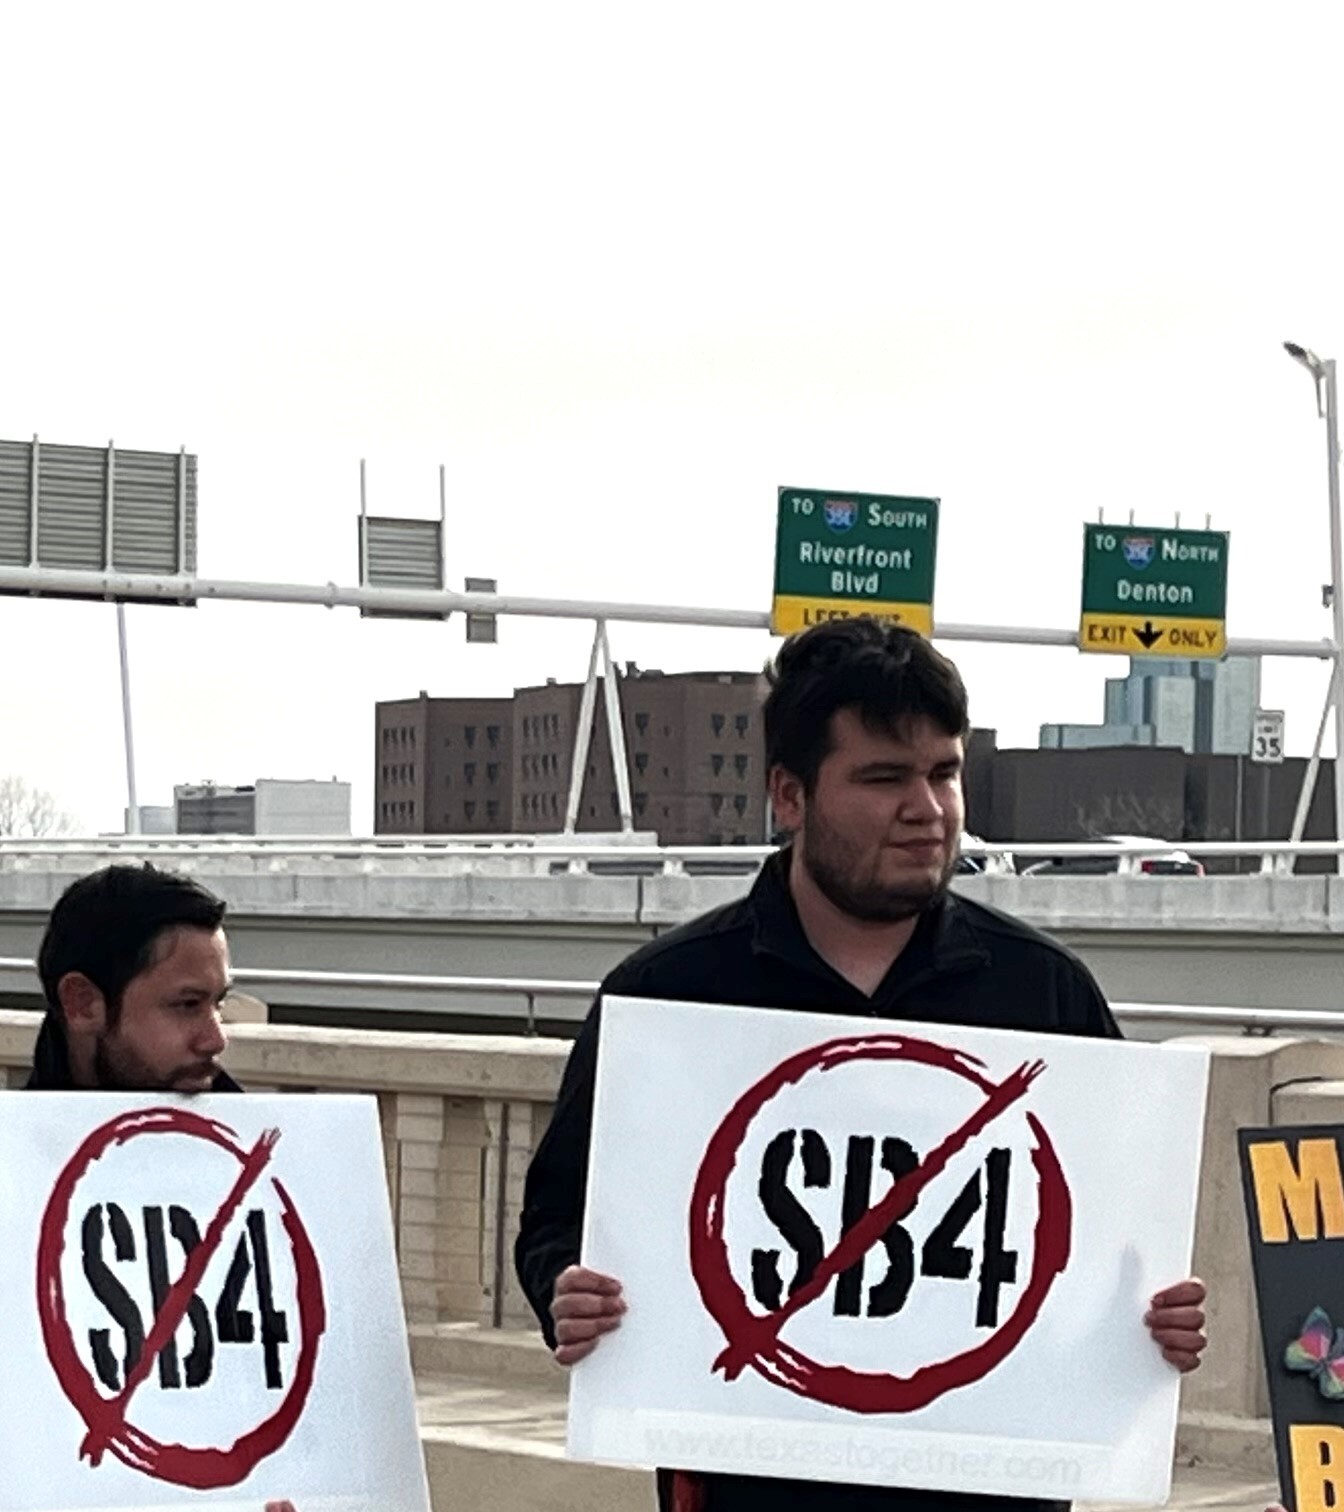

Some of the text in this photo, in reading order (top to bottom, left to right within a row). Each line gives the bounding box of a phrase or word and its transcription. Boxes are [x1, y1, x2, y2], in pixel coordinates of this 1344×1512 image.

[792, 498, 814, 515] TO
[868, 502, 927, 528] SOUTH
[799, 541, 912, 570] Riverfront
[1095, 534, 1116, 550] TO
[1162, 538, 1219, 562] NORTH
[831, 570, 879, 593] Blvd
[1117, 579, 1193, 603] Denton
[1088, 624, 1217, 648] EXIT ONLY
[1255, 736, 1281, 758] 35
[749, 1127, 1018, 1329] SB4
[80, 1201, 290, 1392] SB4
